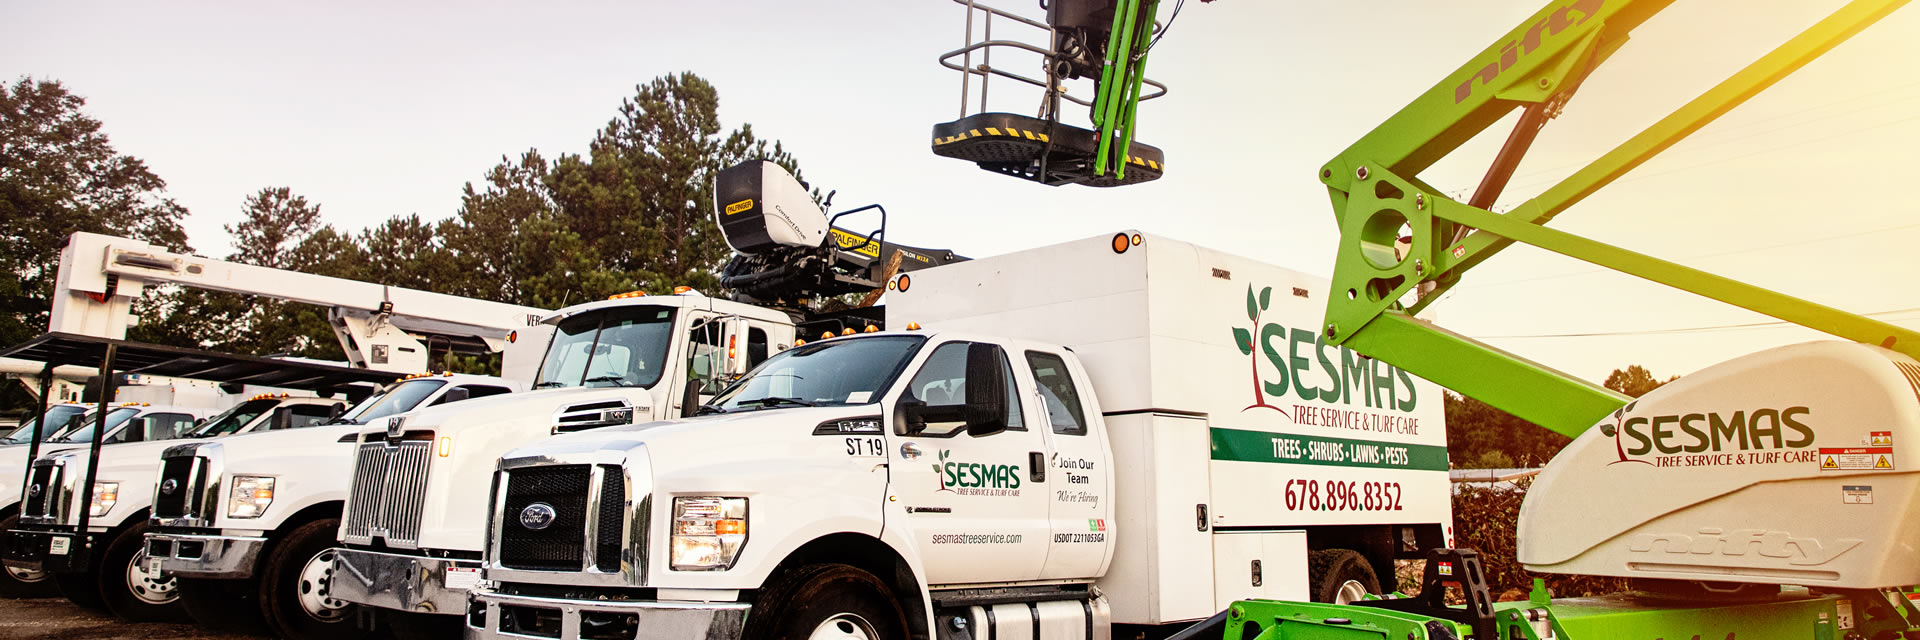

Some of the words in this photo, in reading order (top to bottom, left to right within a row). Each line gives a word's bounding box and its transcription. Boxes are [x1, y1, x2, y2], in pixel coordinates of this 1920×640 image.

[727, 201, 752, 213] PALFINGER
[775, 205, 796, 227] Comfort
[794, 225, 806, 240] Drive
[527, 314, 543, 327] VER
[1261, 323, 1417, 412] SESMAS
[1293, 404, 1318, 425] TREE
[1320, 407, 1360, 430] SERVICE
[1362, 413, 1369, 431] &
[1371, 414, 1394, 433] TURF
[1397, 416, 1418, 435] CARE
[1624, 407, 1815, 455] SESMAS
[845, 437, 862, 455] ST
[866, 438, 883, 456] 19
[1272, 438, 1301, 459] TREES
[1308, 440, 1344, 462] SHRUBS
[1350, 444, 1379, 464] LAWNS
[1385, 446, 1408, 465] PESTS
[1059, 457, 1077, 469] Join
[1079, 458, 1094, 470] Our
[1656, 456, 1682, 467] TREE
[1685, 454, 1733, 467] SERVICE
[1735, 453, 1746, 465] &
[1748, 452, 1781, 464] TURF
[1783, 450, 1817, 463] CARE
[944, 462, 1021, 489] SESMAS
[1066, 472, 1089, 484] Team
[957, 488, 969, 496] TREE
[995, 489, 1007, 497] TURF
[1056, 490, 1077, 502] We're
[1078, 491, 1099, 509] Hiring
[1285, 479, 1403, 512] 678.896.8352
[932, 533, 1022, 544] sesmastreeservice.com
[1054, 533, 1073, 543] USDOT
[1630, 528, 1863, 566] nifty
